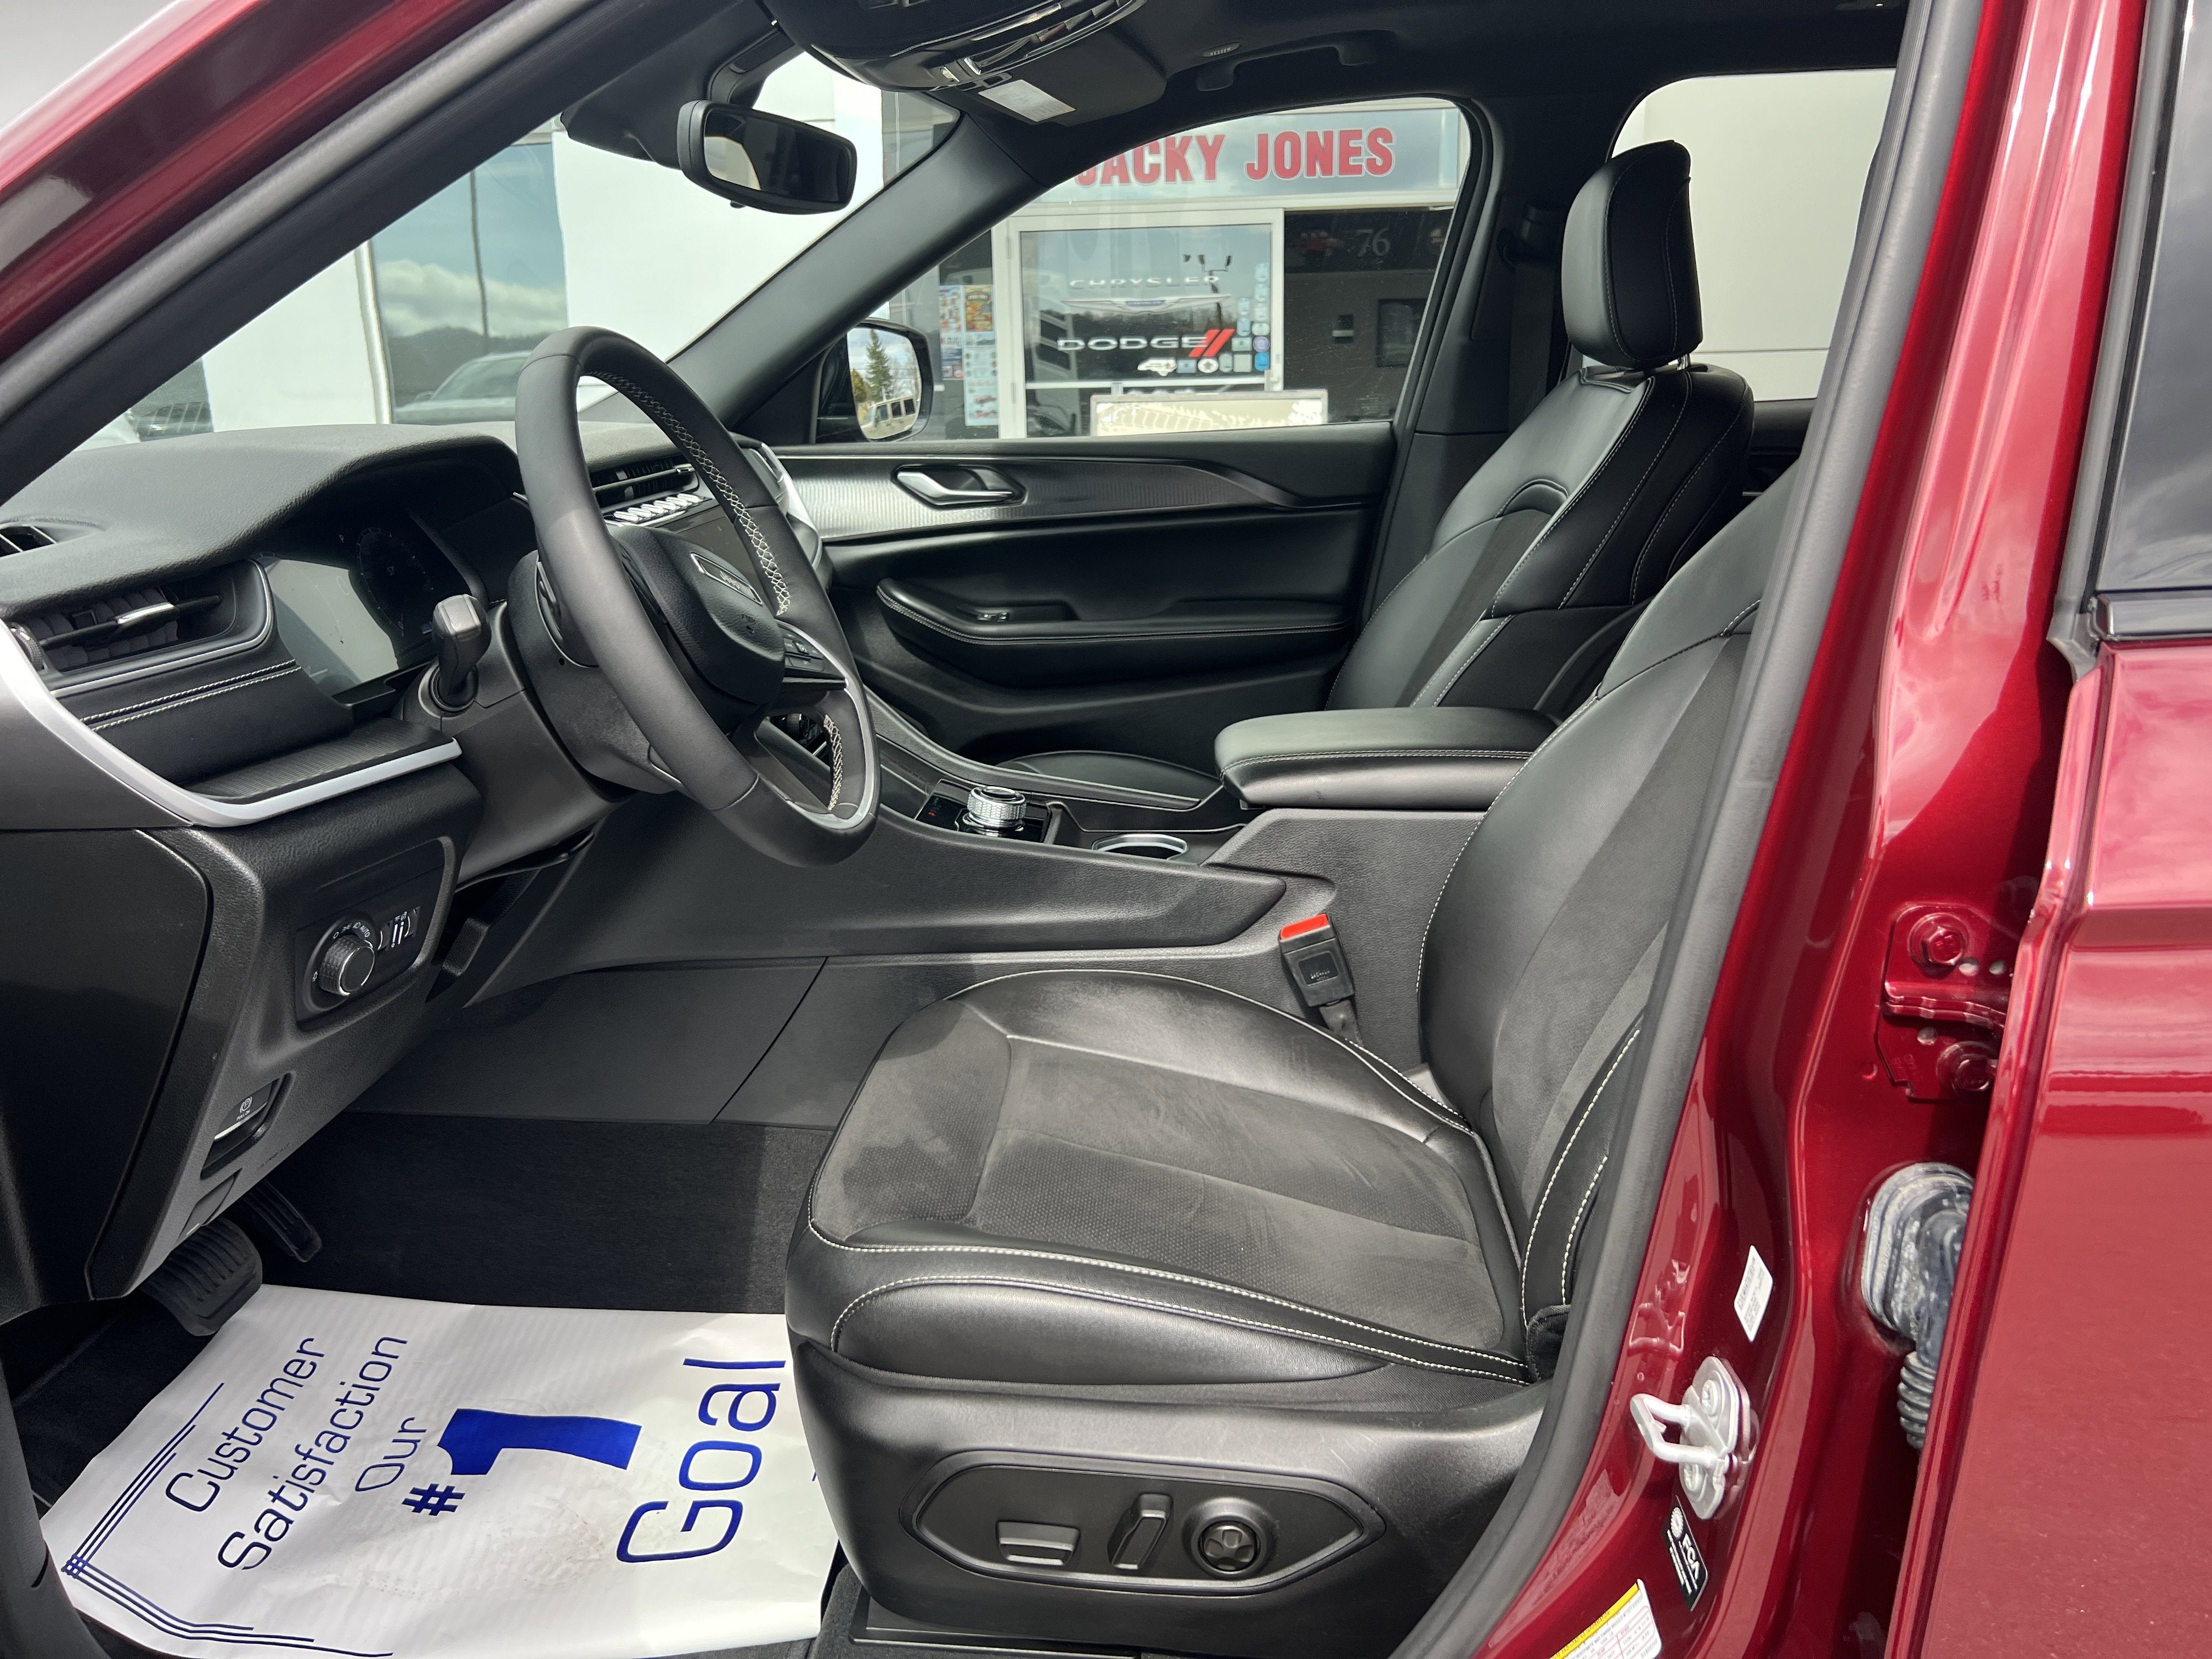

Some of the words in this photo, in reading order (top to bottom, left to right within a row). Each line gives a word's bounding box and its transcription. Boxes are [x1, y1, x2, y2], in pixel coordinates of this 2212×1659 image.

[1245, 127, 1393, 180] JONES
[1356, 227, 1391, 256] 76
[1069, 275, 1220, 287] CHRYSLER
[1057, 335, 1208, 351] DODGE
[165, 1337, 325, 1513] Customer
[217, 1336, 408, 1571] Satisfaction
[354, 1417, 427, 1492] Our
[616, 1358, 786, 1563] Goal
[1682, 1533, 1700, 1583] FCA
